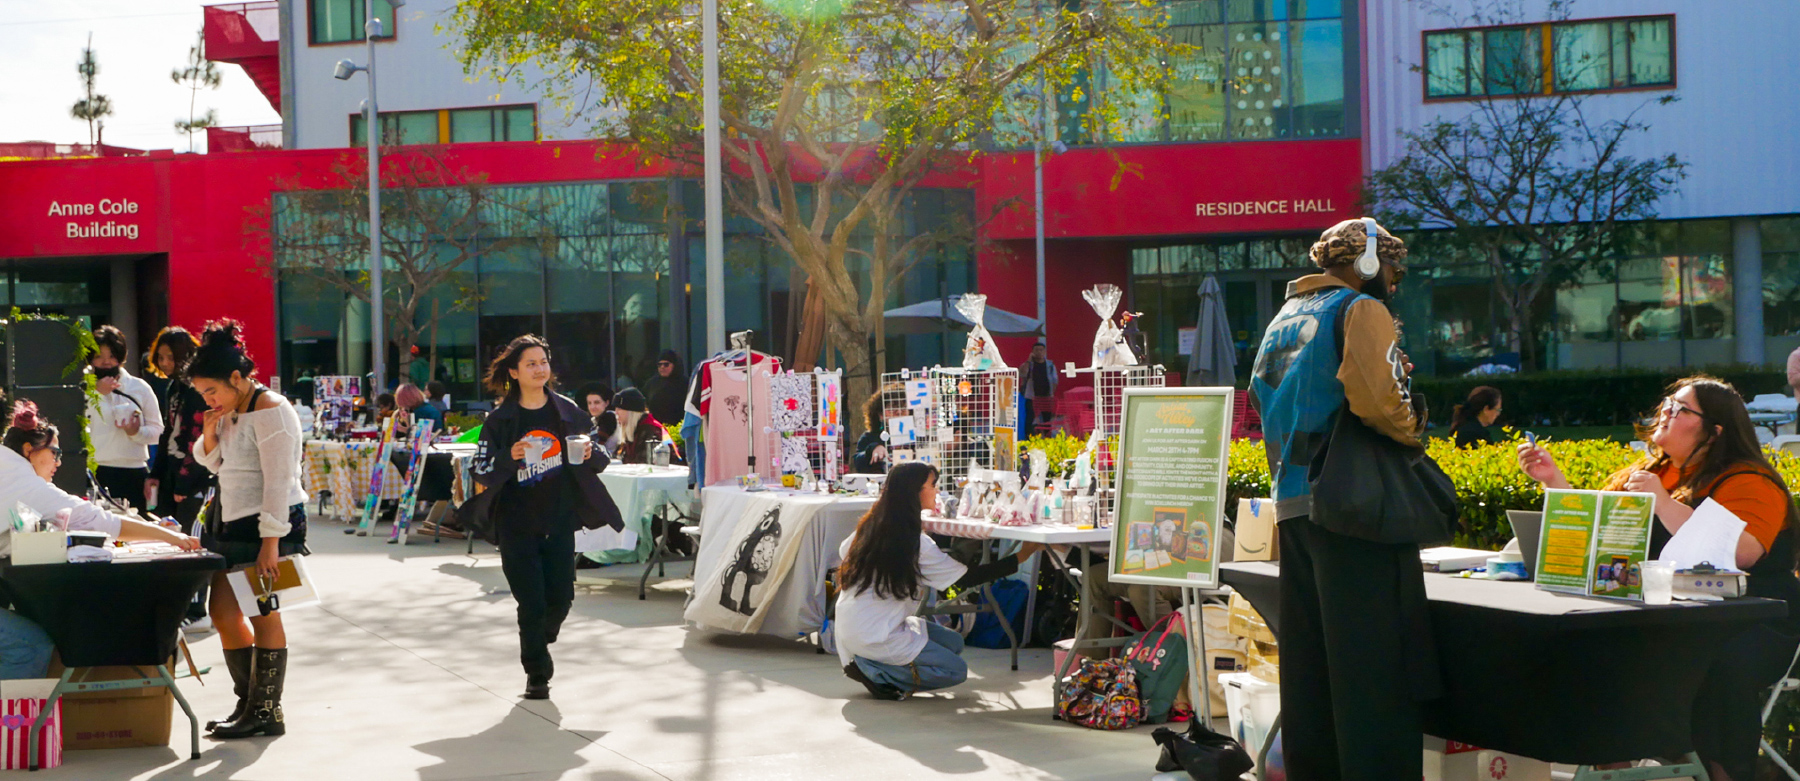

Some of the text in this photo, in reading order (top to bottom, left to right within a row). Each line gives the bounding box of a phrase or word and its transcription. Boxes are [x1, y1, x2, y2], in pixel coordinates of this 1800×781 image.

[48, 198, 139, 216] Anne Cole
[1196, 199, 1335, 216] RESIDENCE HALL
[66, 221, 139, 240] Building
